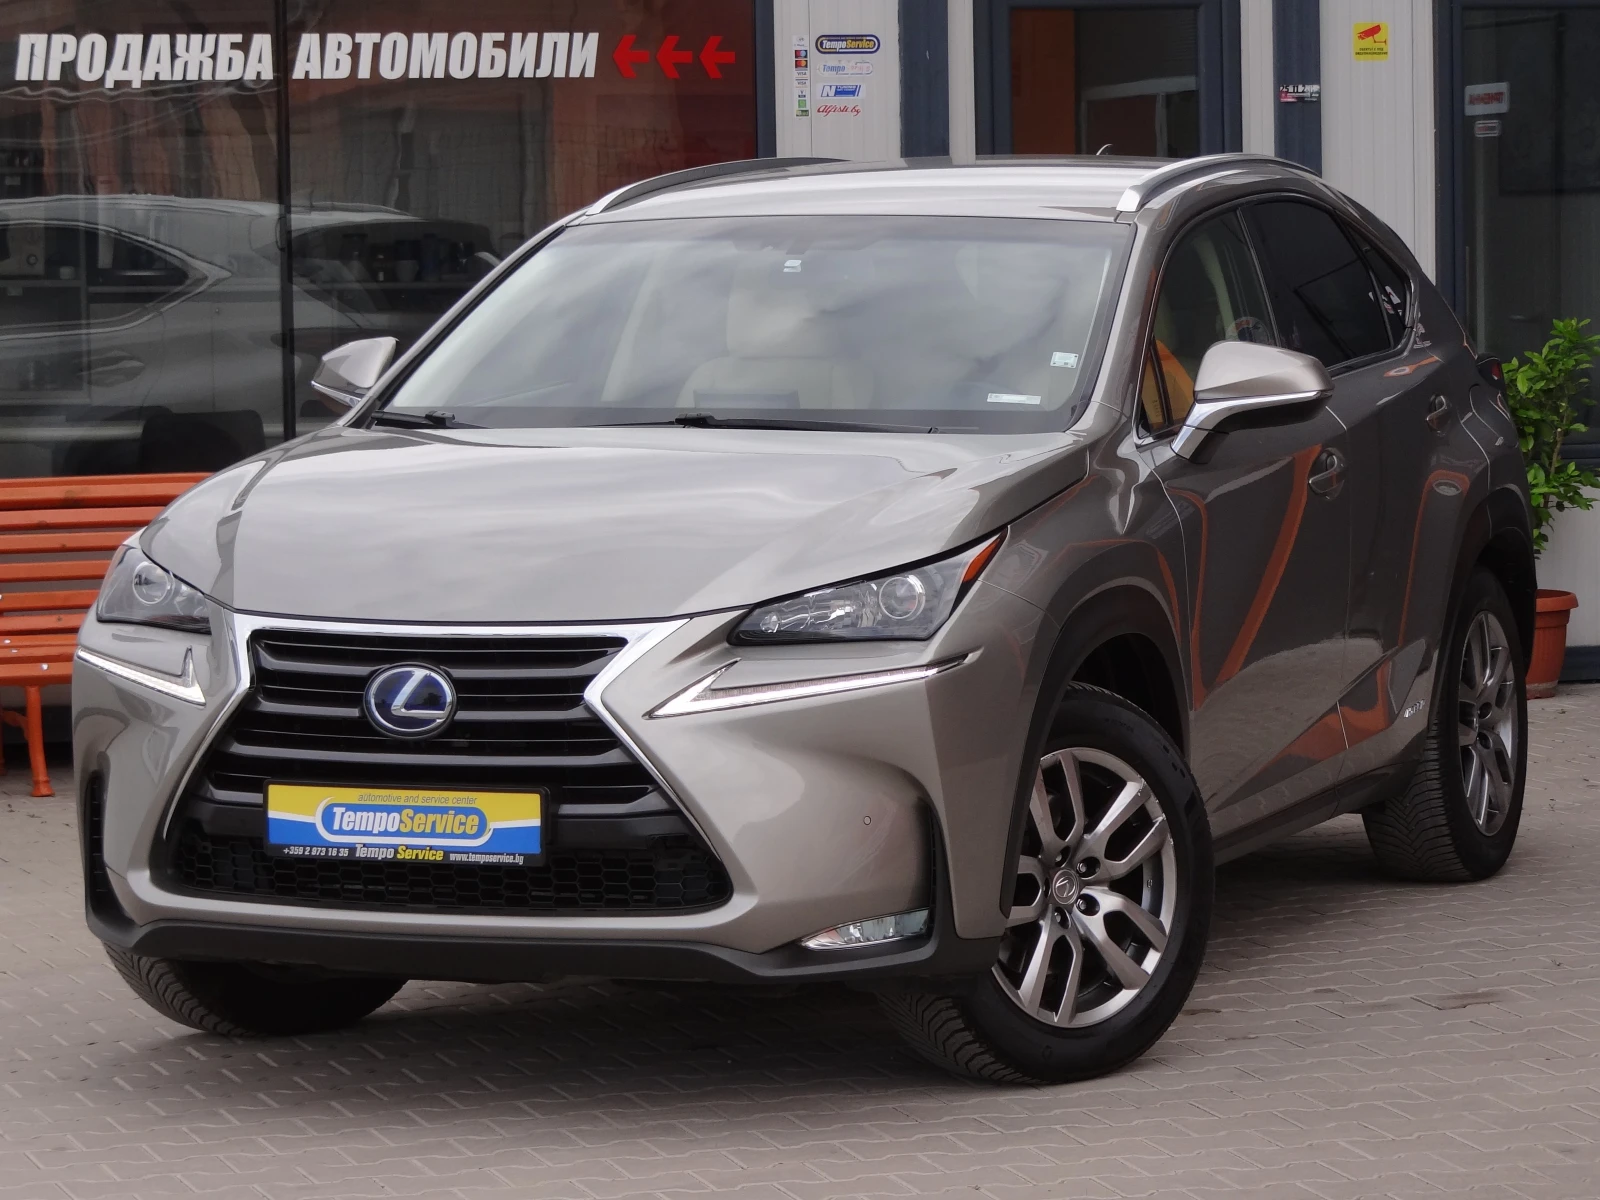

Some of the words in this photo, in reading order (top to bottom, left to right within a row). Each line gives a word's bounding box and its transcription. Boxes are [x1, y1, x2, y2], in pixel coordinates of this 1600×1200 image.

[822, 39, 875, 52] TempoService
[15, 33, 274, 88] ПРОДАЖБА
[292, 31, 599, 79] АВТОМОБИЛИ
[358, 793, 402, 803] automotive
[403, 794, 420, 804] and
[421, 794, 450, 805] service
[451, 795, 478, 805] center
[333, 807, 480, 835] TempoService
[283, 846, 304, 855] +359
[304, 846, 311, 855] 2
[311, 847, 326, 856] 973
[355, 844, 395, 860] Tempo
[397, 844, 444, 861] Service
[449, 852, 524, 865] www.temposervice.bg
